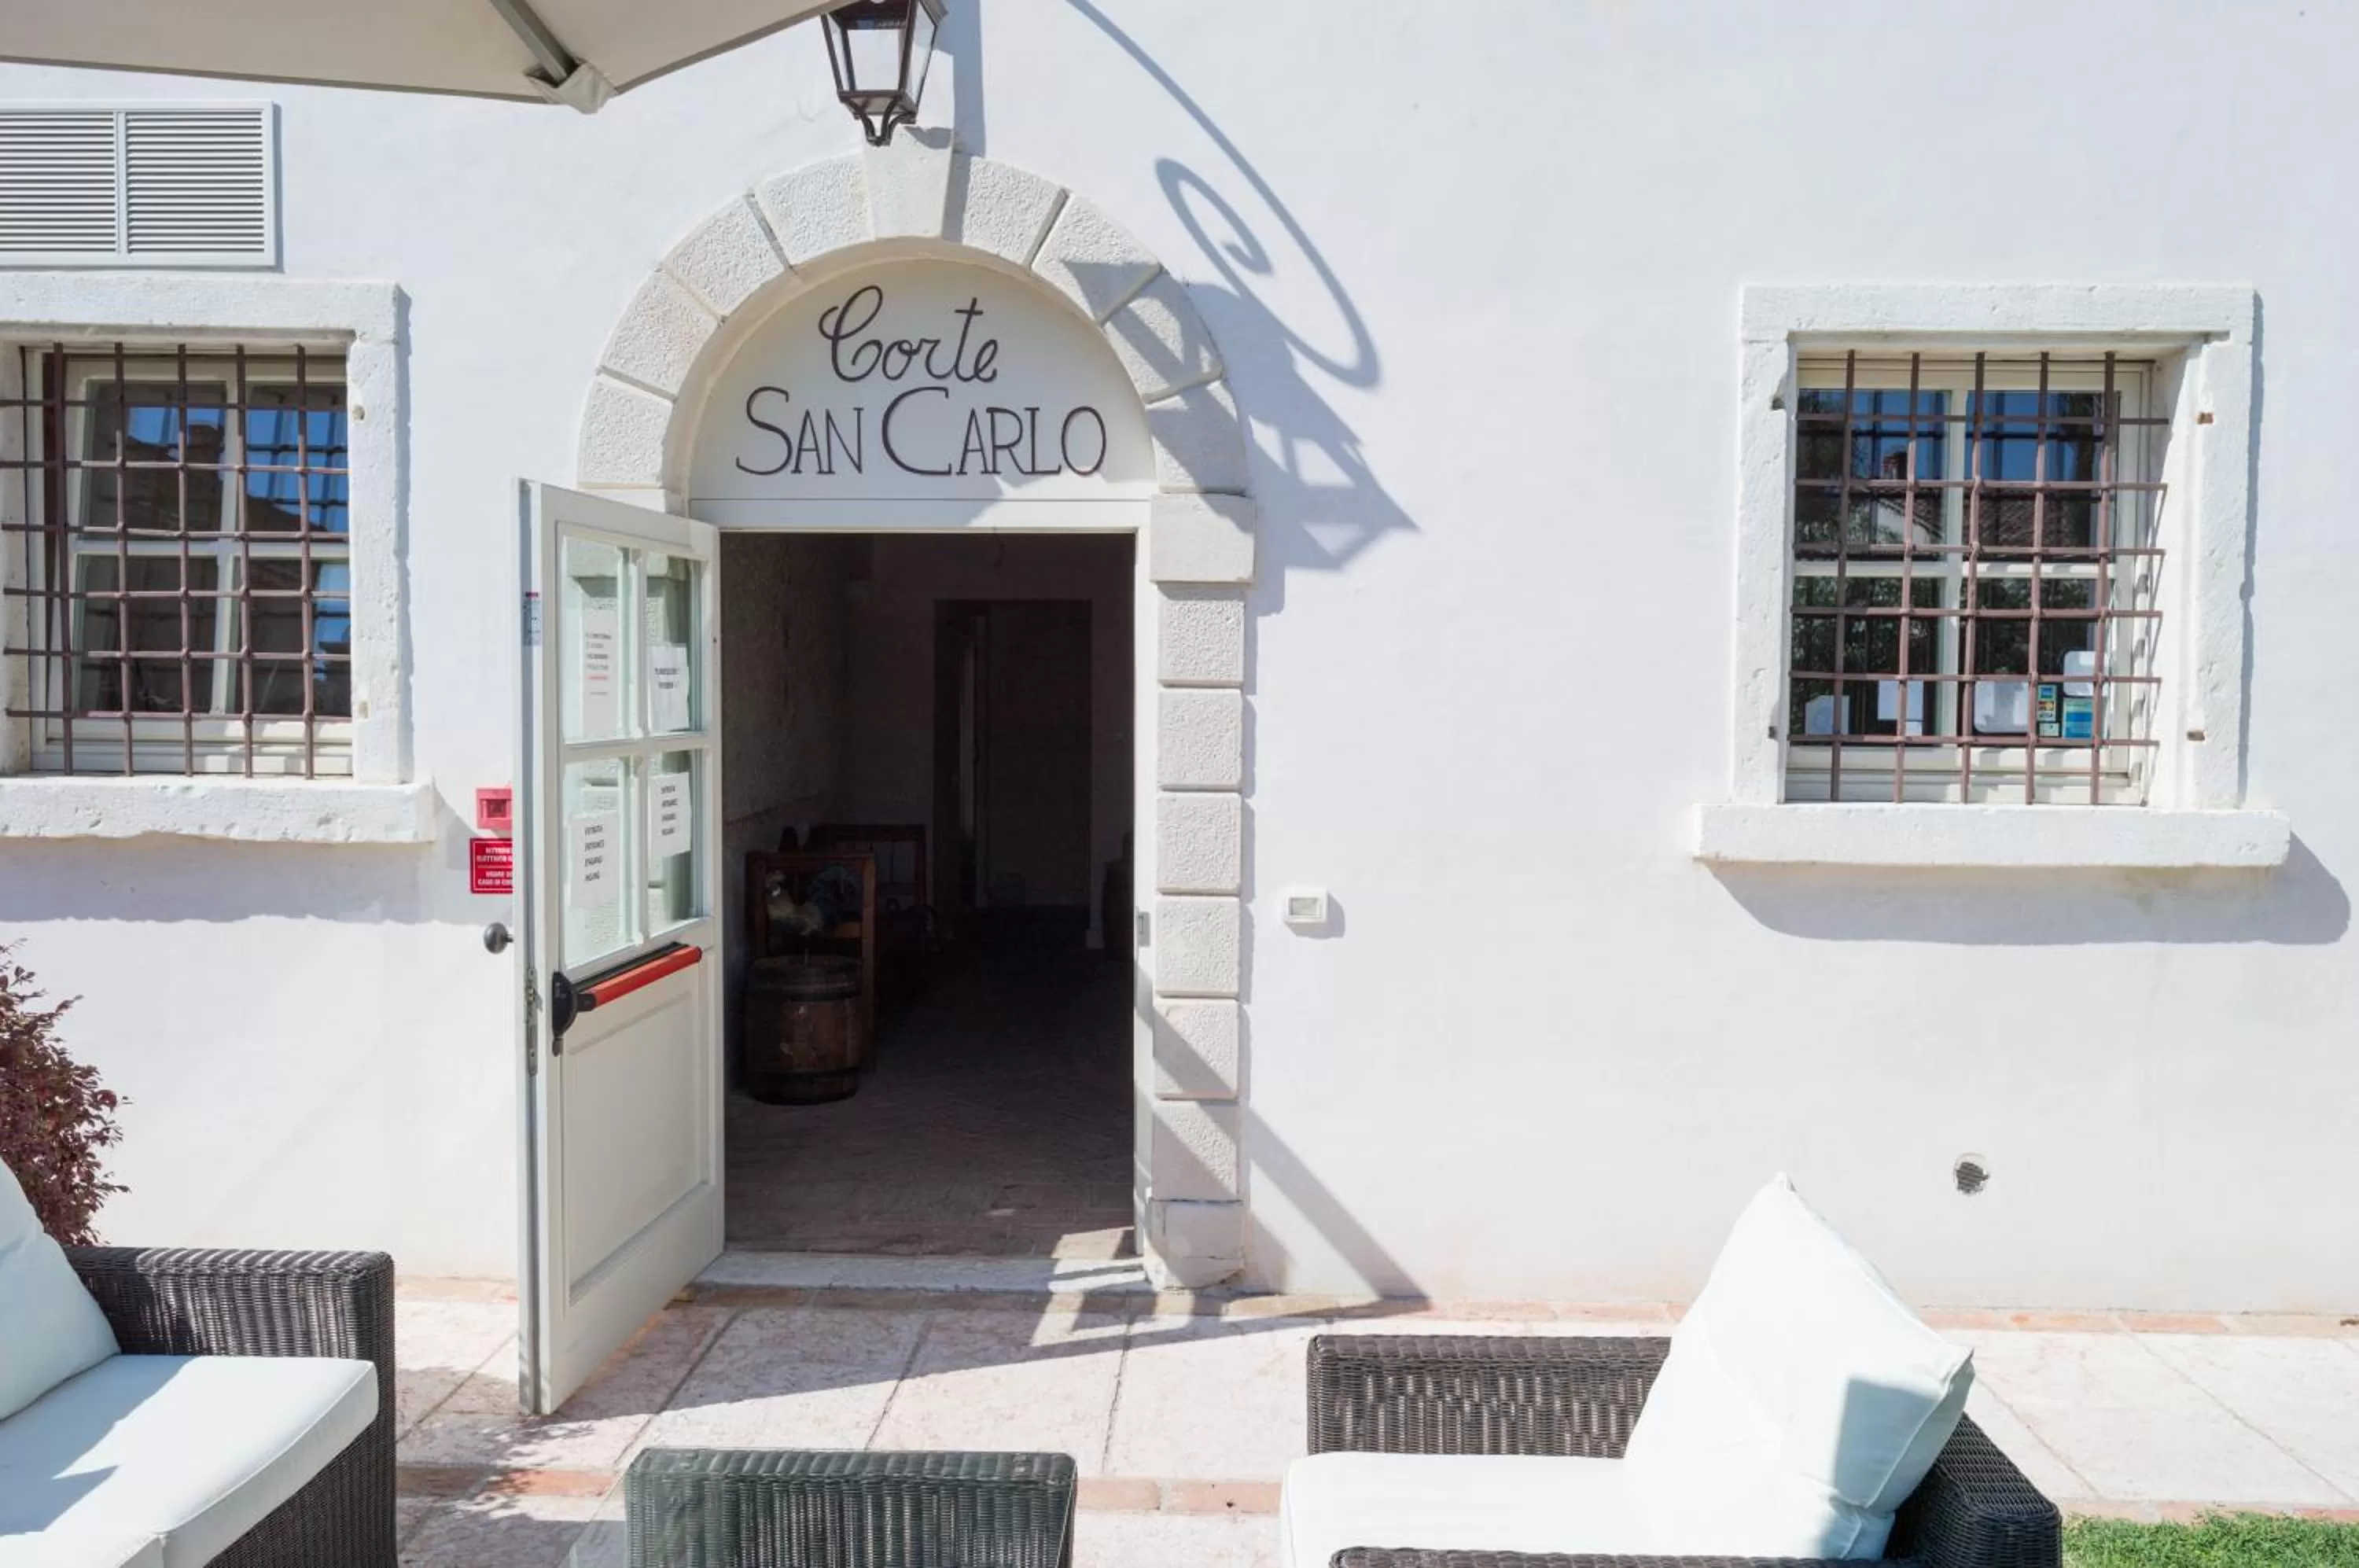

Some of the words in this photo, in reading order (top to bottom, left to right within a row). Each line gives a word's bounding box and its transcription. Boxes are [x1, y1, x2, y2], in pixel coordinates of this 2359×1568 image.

[819, 285, 999, 383] Corte
[735, 386, 864, 476] SAN
[881, 386, 1107, 476] CARLO
